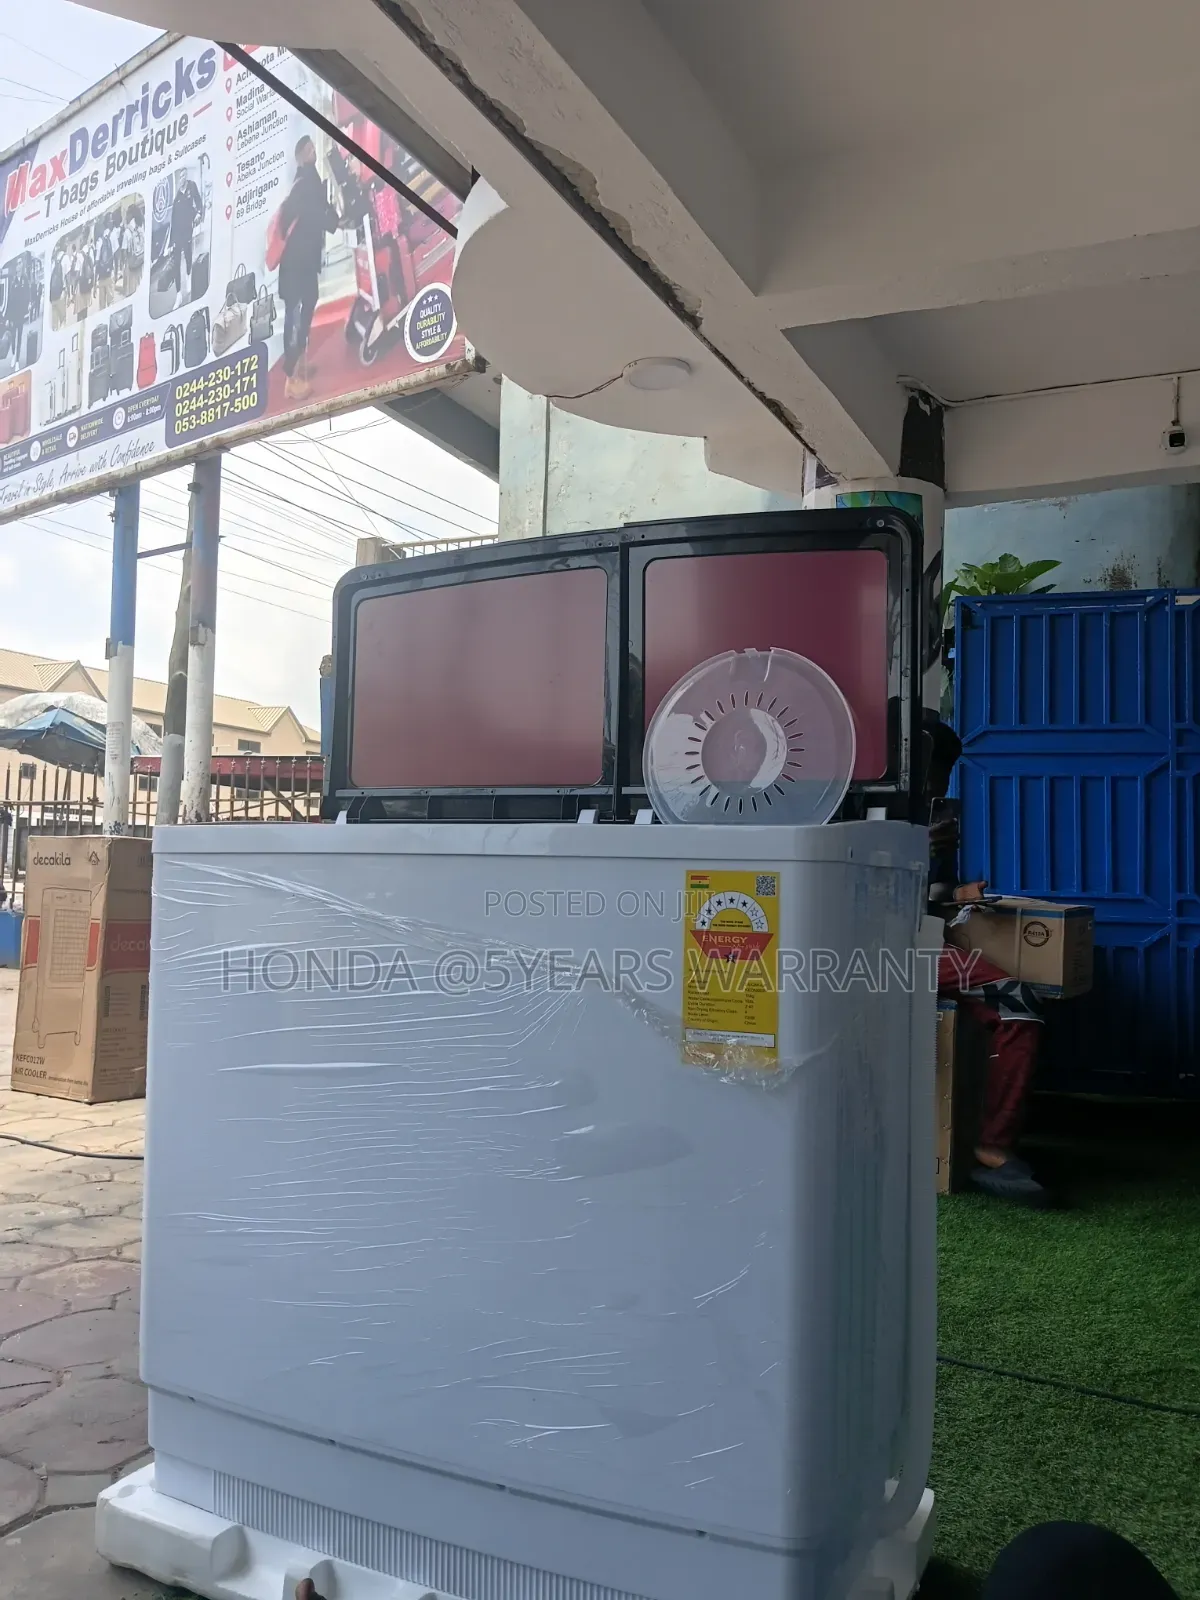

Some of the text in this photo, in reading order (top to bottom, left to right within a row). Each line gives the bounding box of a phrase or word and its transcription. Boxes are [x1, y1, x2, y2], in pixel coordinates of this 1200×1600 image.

[236, 83, 265, 109] Madina
[236, 99, 255, 119] Social
[6, 47, 217, 212] MaxDerricks
[236, 109, 278, 142] Ashiaman
[261, 114, 288, 136] Junction
[44, 113, 189, 218] T bags Boutique
[236, 151, 266, 174] Tesano
[257, 150, 285, 172] Junction
[24, 222, 60, 248] MaxDerricks
[60, 211, 79, 228] House
[79, 205, 88, 217] of
[87, 188, 116, 213] affordable
[148, 162, 166, 177] bags
[167, 153, 173, 165] &
[174, 133, 207, 161] Suitcases
[236, 197, 267, 219] 69 Bridge
[416, 311, 446, 331] DURABILITY
[419, 302, 442, 319] QUALITY
[421, 326, 437, 339] STYLE
[175, 354, 259, 400] 0244-230-172
[175, 372, 257, 417] 0244-230-171
[174, 391, 258, 435] 053-8817-500
[110, 437, 156, 468] Confidence
[33, 851, 72, 866] decakila
[702, 933, 748, 944] ENERGY
[14, 1067, 48, 1080] AIR COOLER
